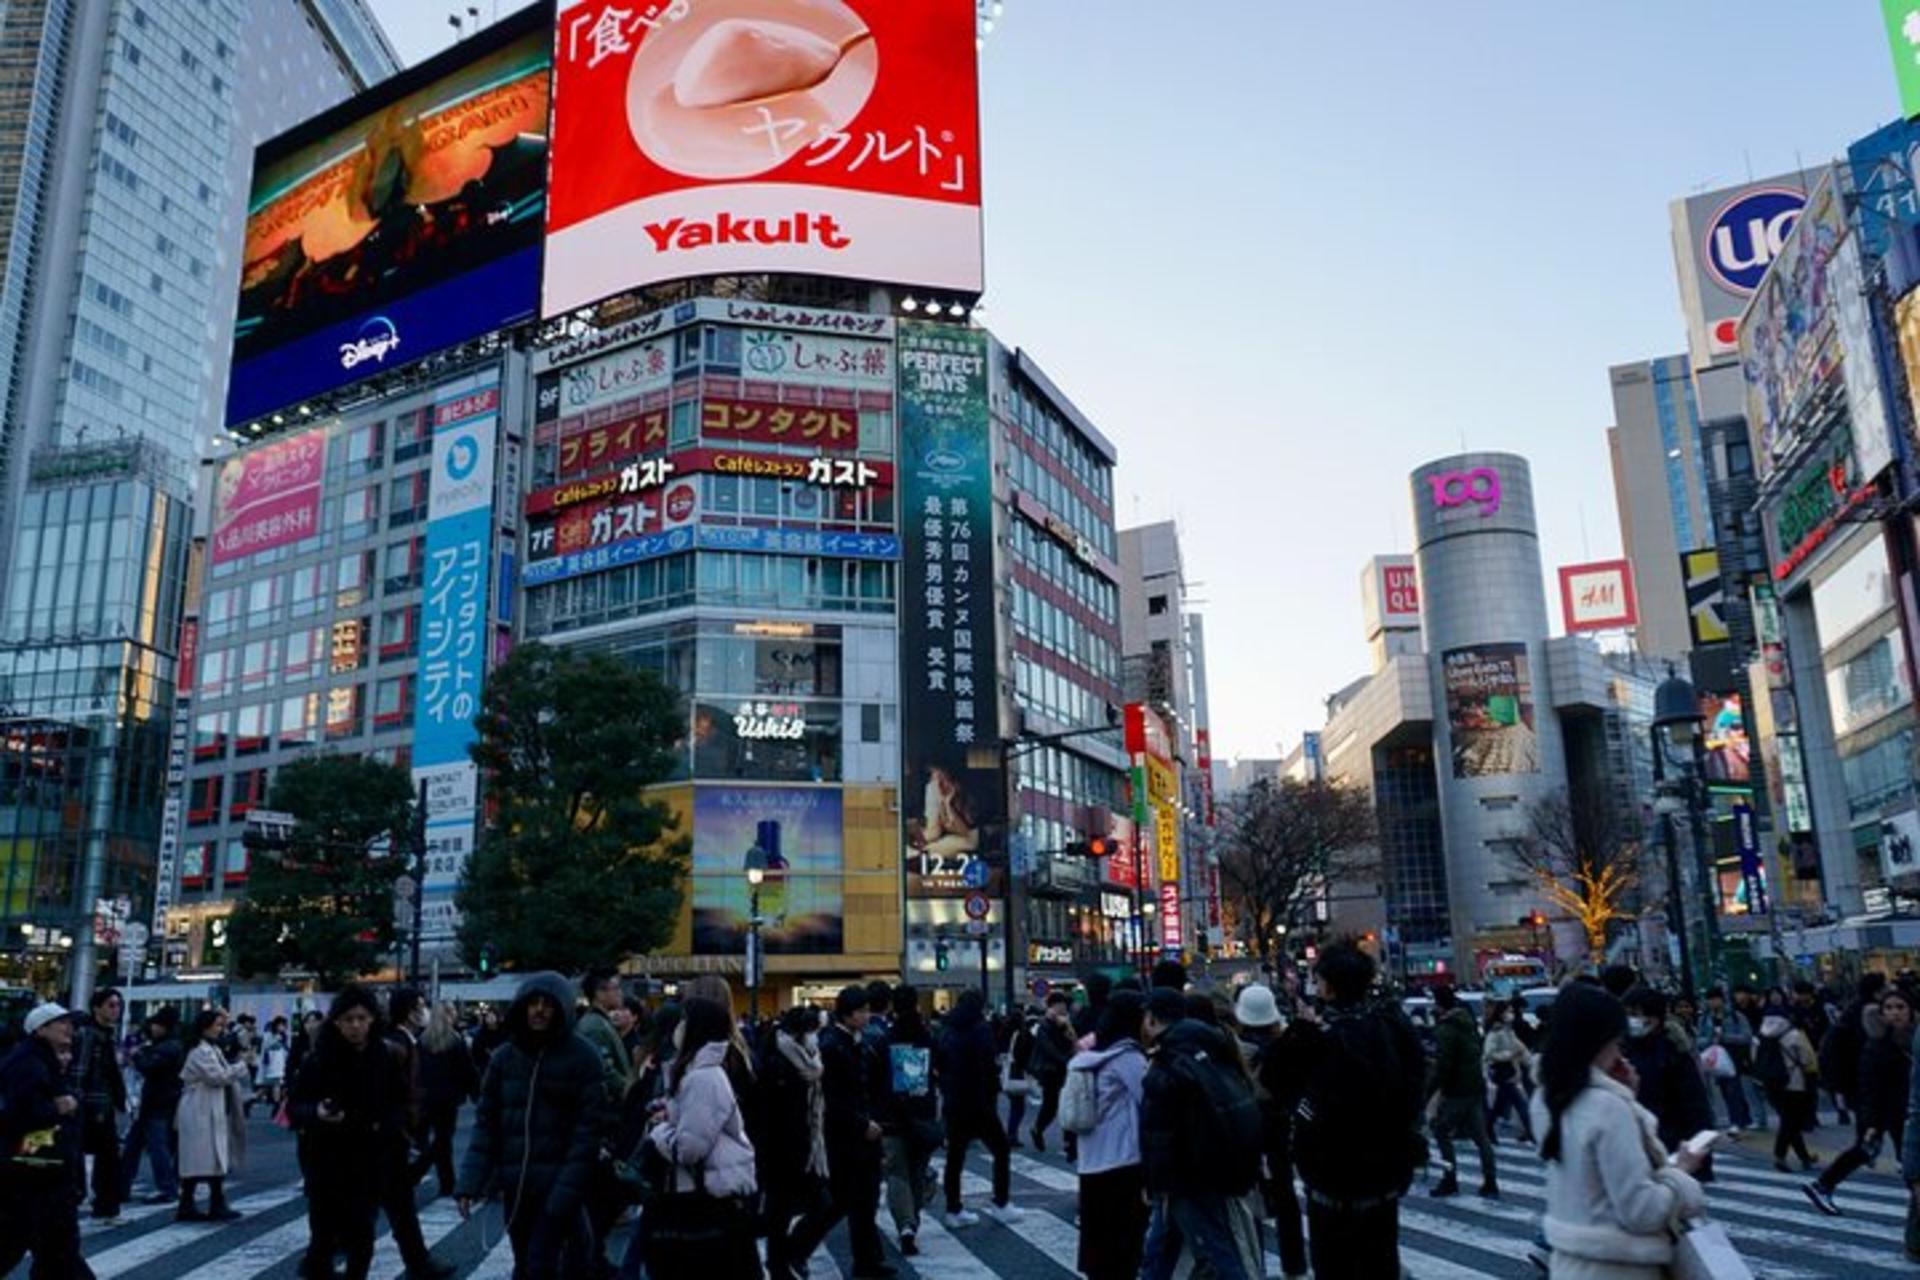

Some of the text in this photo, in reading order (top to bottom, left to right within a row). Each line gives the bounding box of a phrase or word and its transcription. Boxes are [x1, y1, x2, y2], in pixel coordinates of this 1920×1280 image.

[644, 212, 851, 252] Yakult
[728, 302, 886, 333] しゃぶしゃぶバイキング
[794, 342, 886, 376] しゃぶ葉
[903, 351, 984, 377] PERFECT
[920, 372, 968, 393] DAYS
[703, 403, 853, 440] コンタクト
[620, 458, 675, 493] ガスト
[808, 458, 879, 486] ガスト
[1427, 466, 1500, 518] 109
[531, 527, 556, 551] 7F
[591, 501, 657, 545] ガスト
[923, 496, 947, 691] 最優秀男優賞 受賞
[424, 546, 458, 724] アイシティ
[452, 541, 481, 720] コンタクトの
[950, 498, 975, 743] 第76回カンヌ国際映画祭
